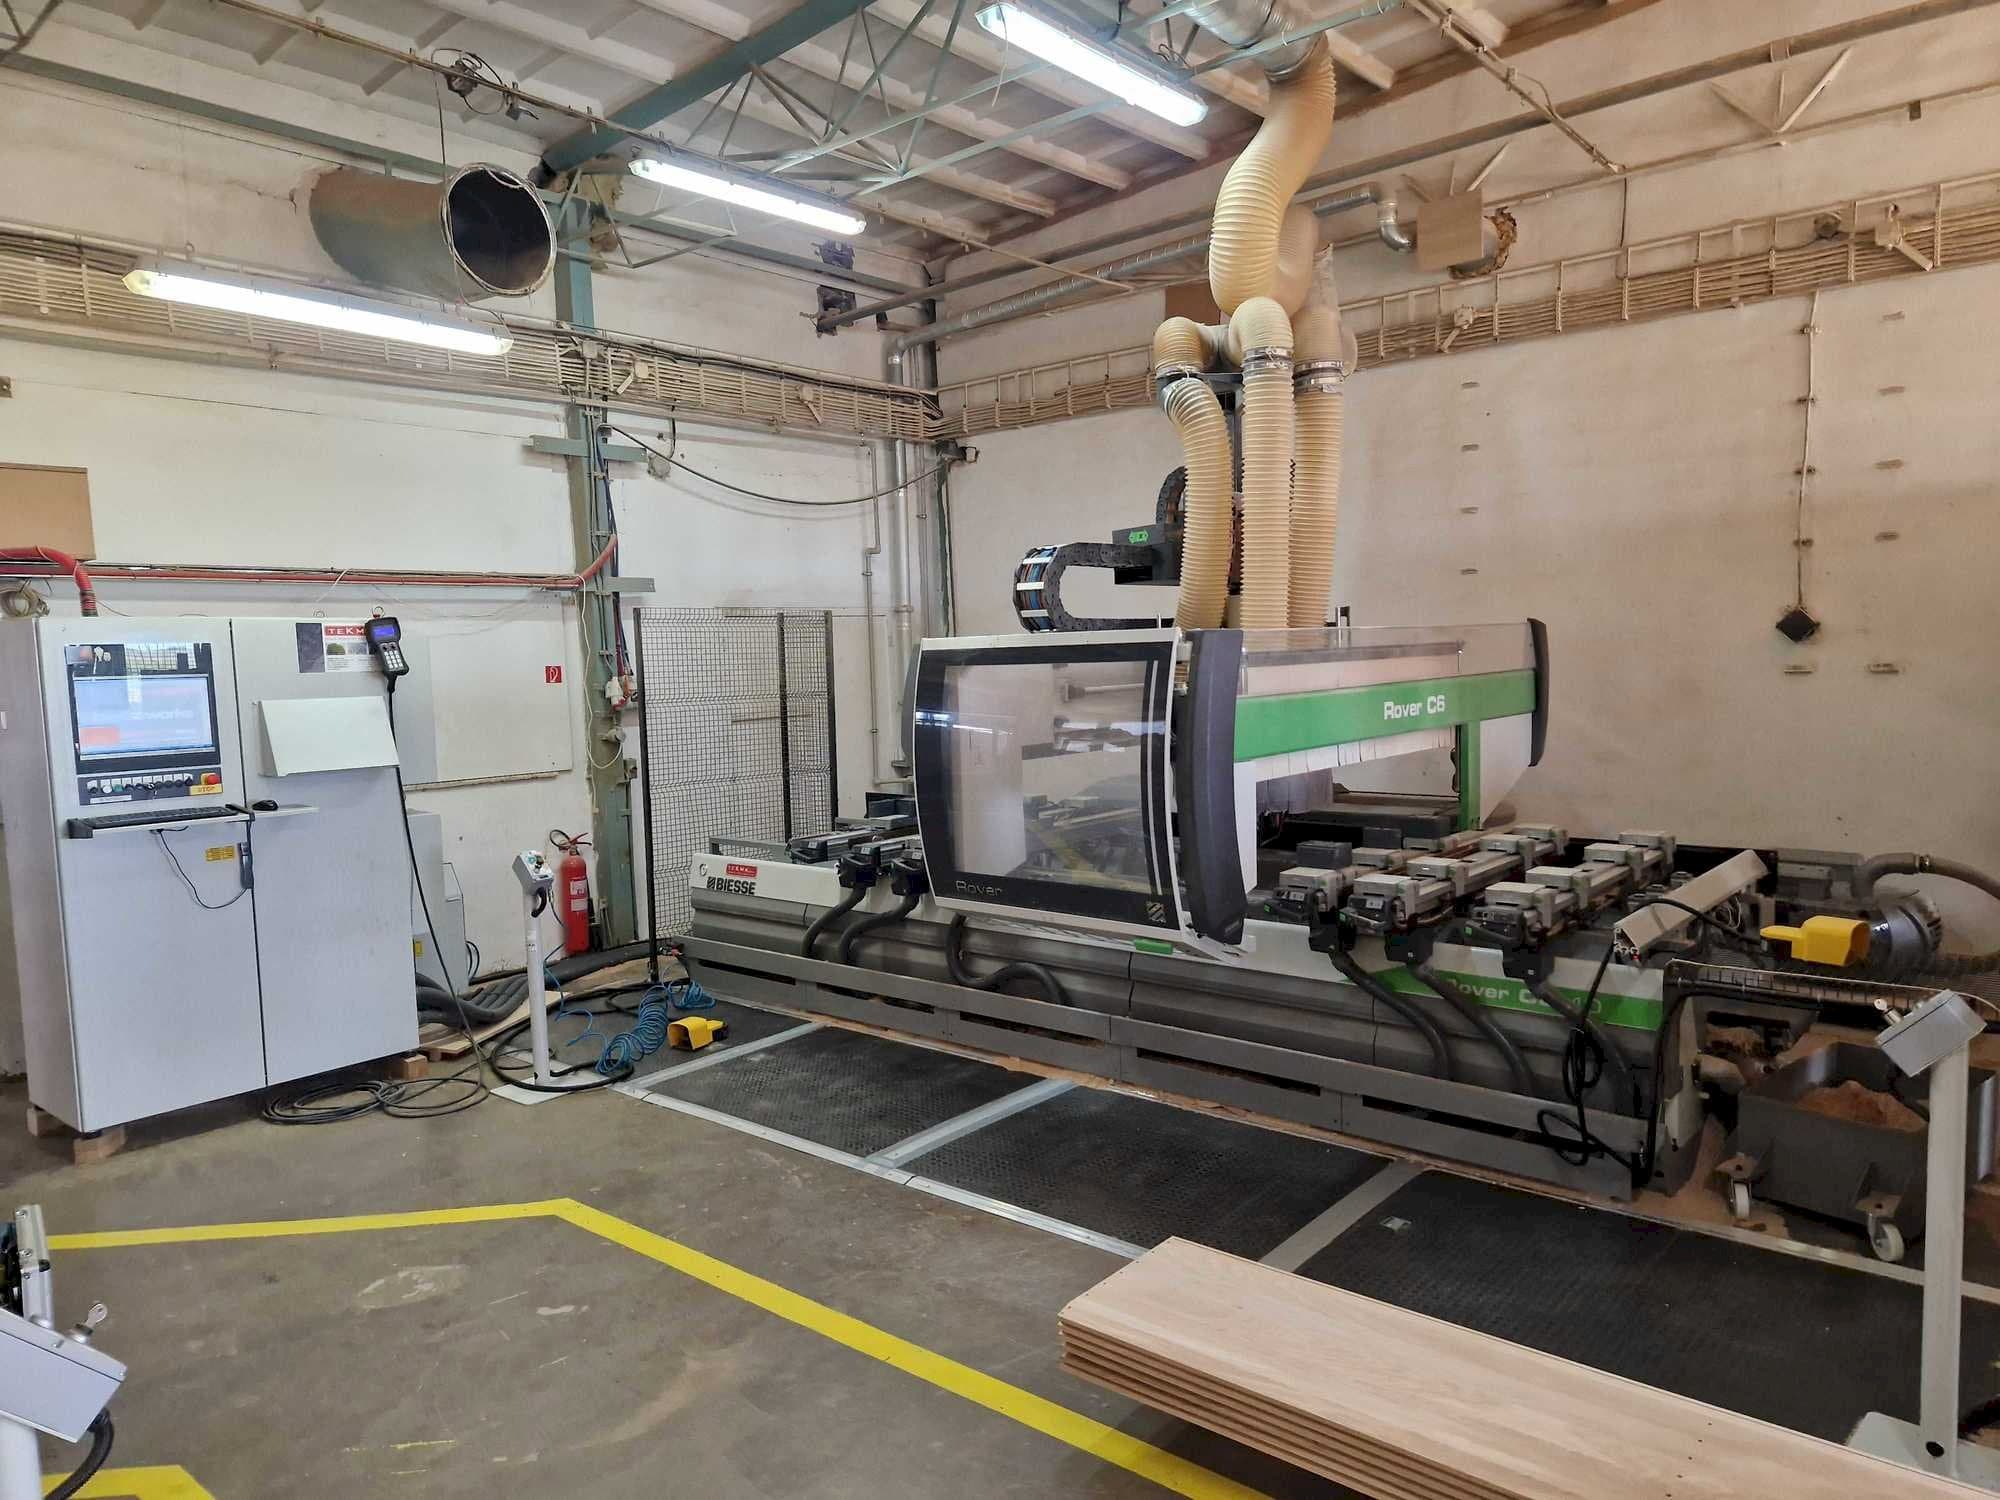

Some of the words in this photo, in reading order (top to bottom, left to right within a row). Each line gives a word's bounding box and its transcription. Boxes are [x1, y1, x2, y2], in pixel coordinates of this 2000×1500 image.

[1384, 701, 1422, 720] Rover
[1427, 695, 1445, 714] C6
[716, 877, 756, 894] BIESSE
[955, 880, 1002, 897] Rover
